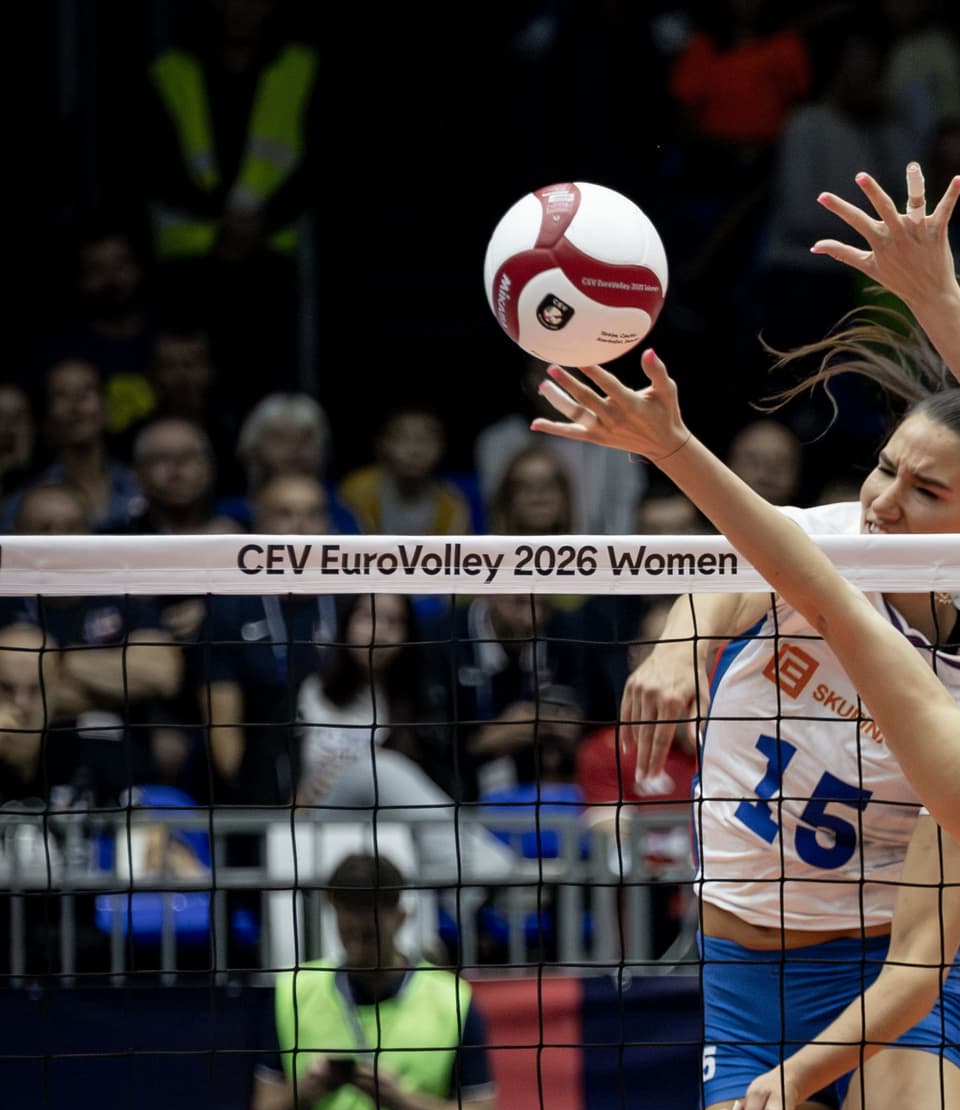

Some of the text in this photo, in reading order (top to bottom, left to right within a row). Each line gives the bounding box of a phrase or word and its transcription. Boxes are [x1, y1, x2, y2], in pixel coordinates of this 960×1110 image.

[237, 543, 738, 584] CEV EuroVolley 2026 Women
[734, 734, 873, 870] 15
